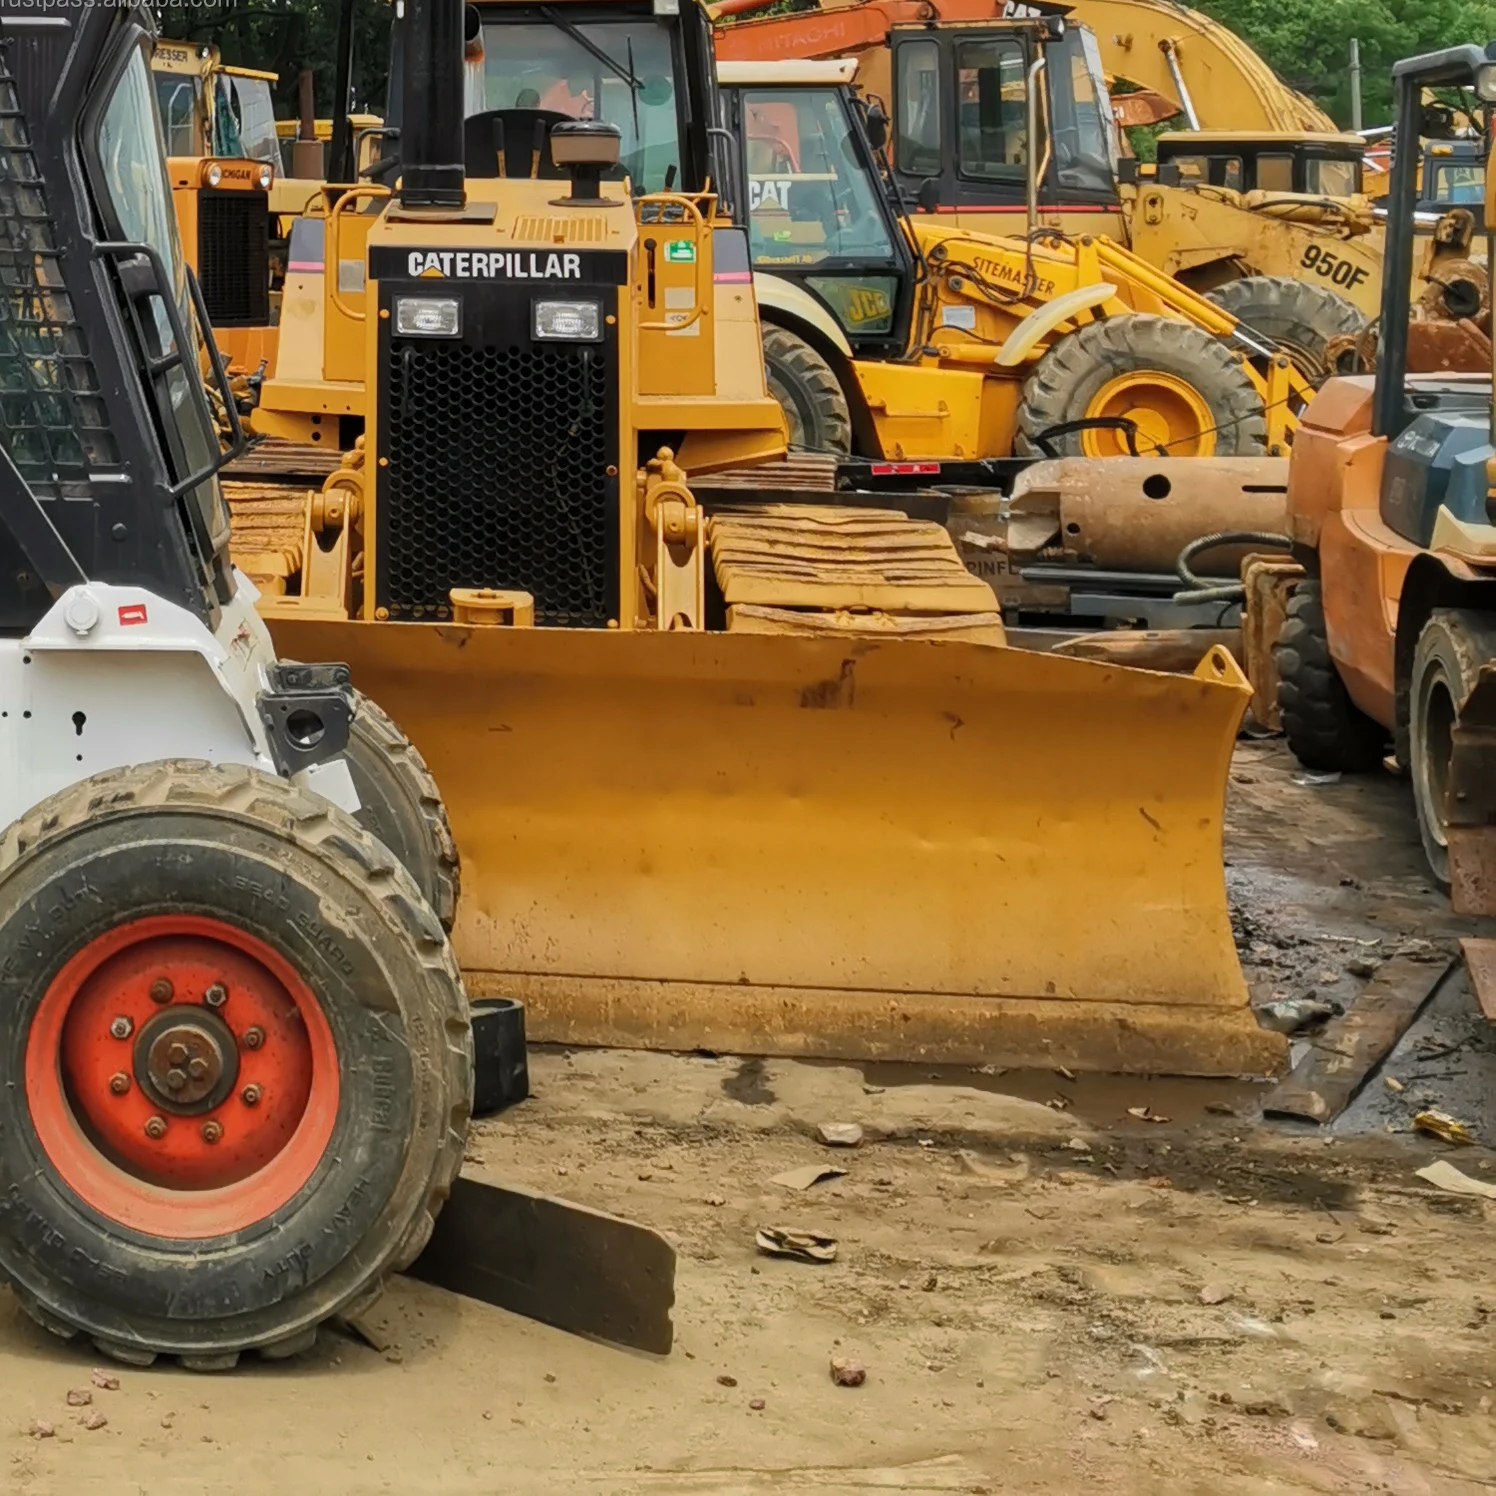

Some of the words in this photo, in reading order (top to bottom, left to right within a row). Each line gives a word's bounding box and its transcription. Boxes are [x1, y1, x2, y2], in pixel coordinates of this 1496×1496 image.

[749, 181, 792, 211] CAT
[407, 251, 582, 279] CATERPILLAR
[1300, 244, 1370, 290] 950F
